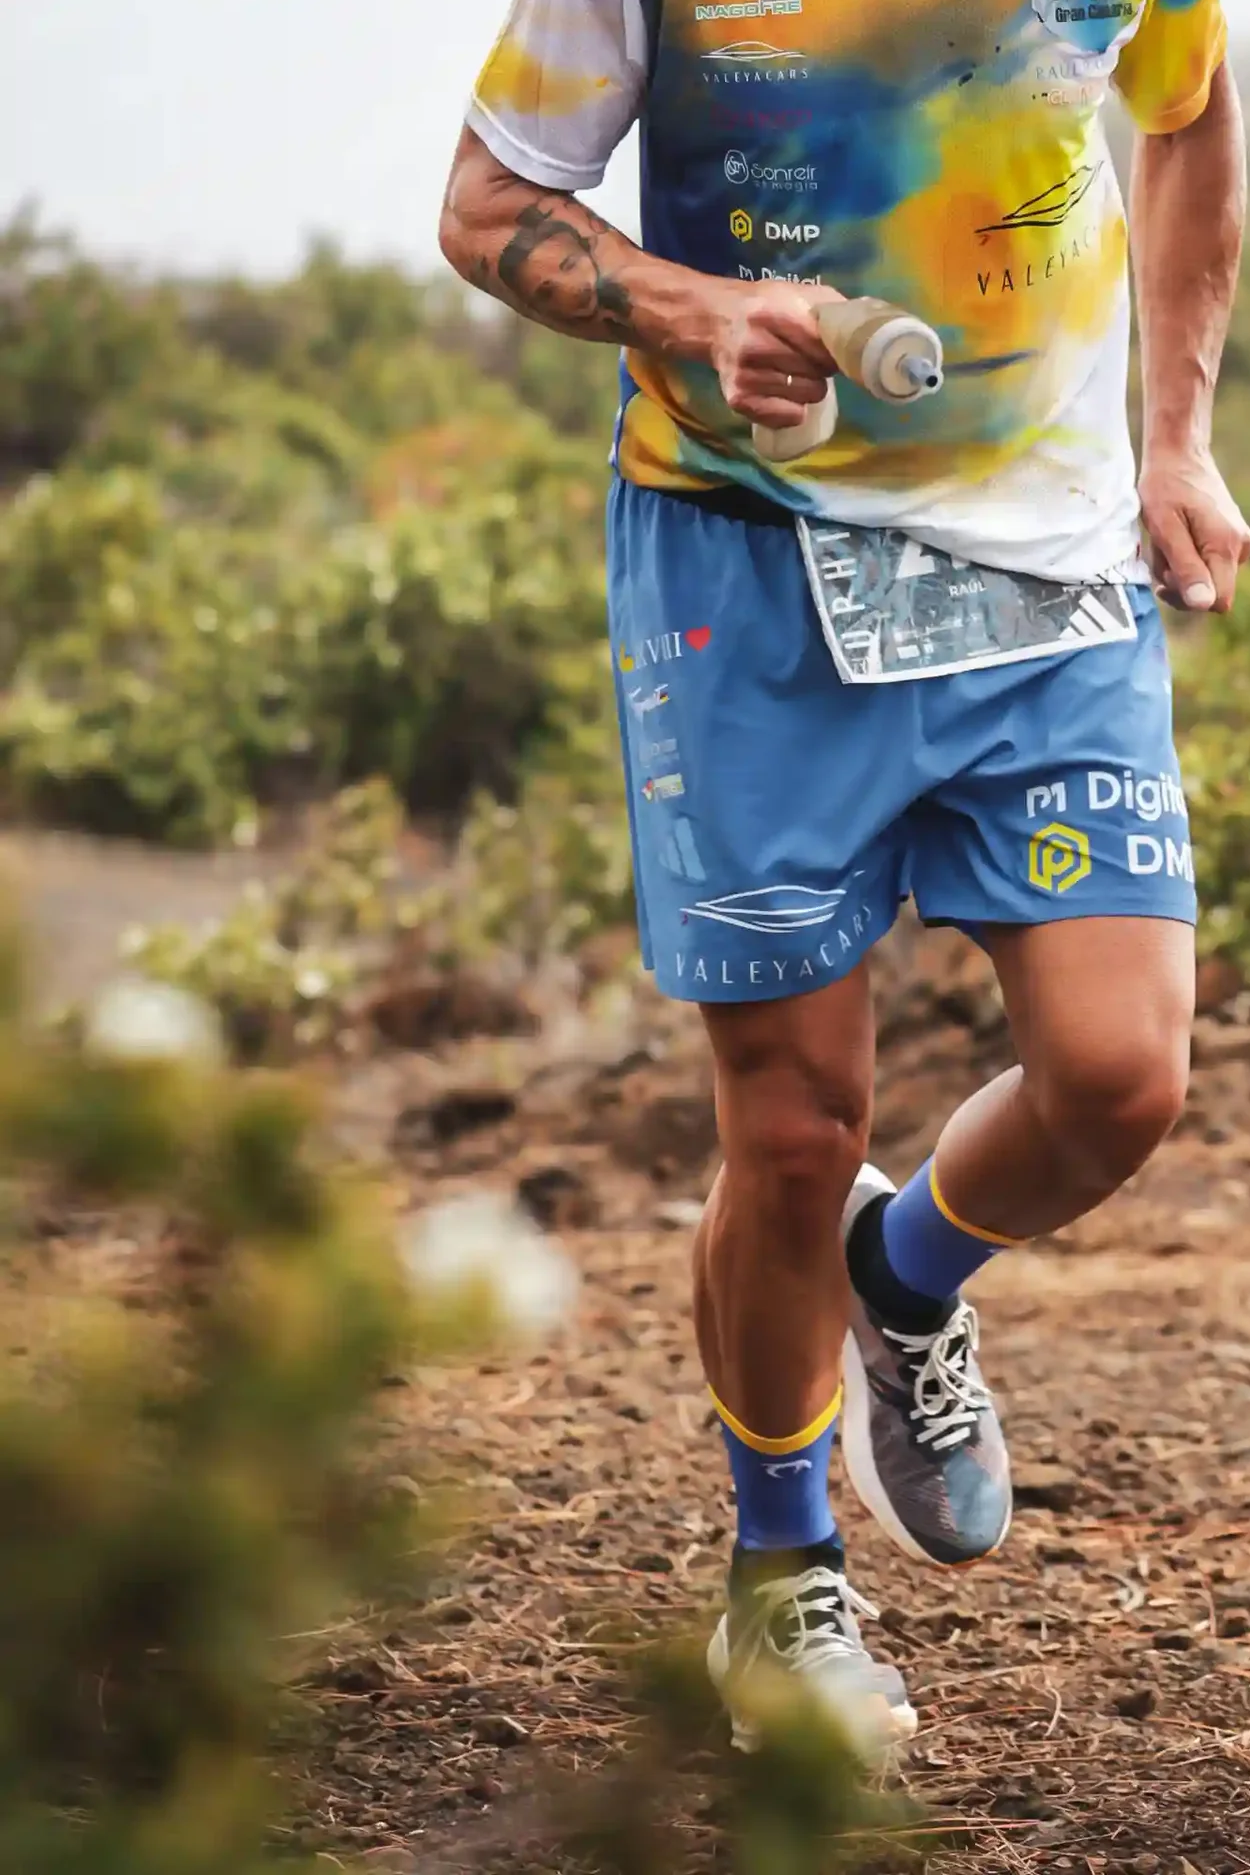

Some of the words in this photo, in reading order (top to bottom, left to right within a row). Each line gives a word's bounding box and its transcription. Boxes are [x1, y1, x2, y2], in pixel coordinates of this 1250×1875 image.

[1055, 7, 1086, 23] Gran
[702, 68, 809, 84] VALEYACARS
[764, 221, 821, 243] DMP
